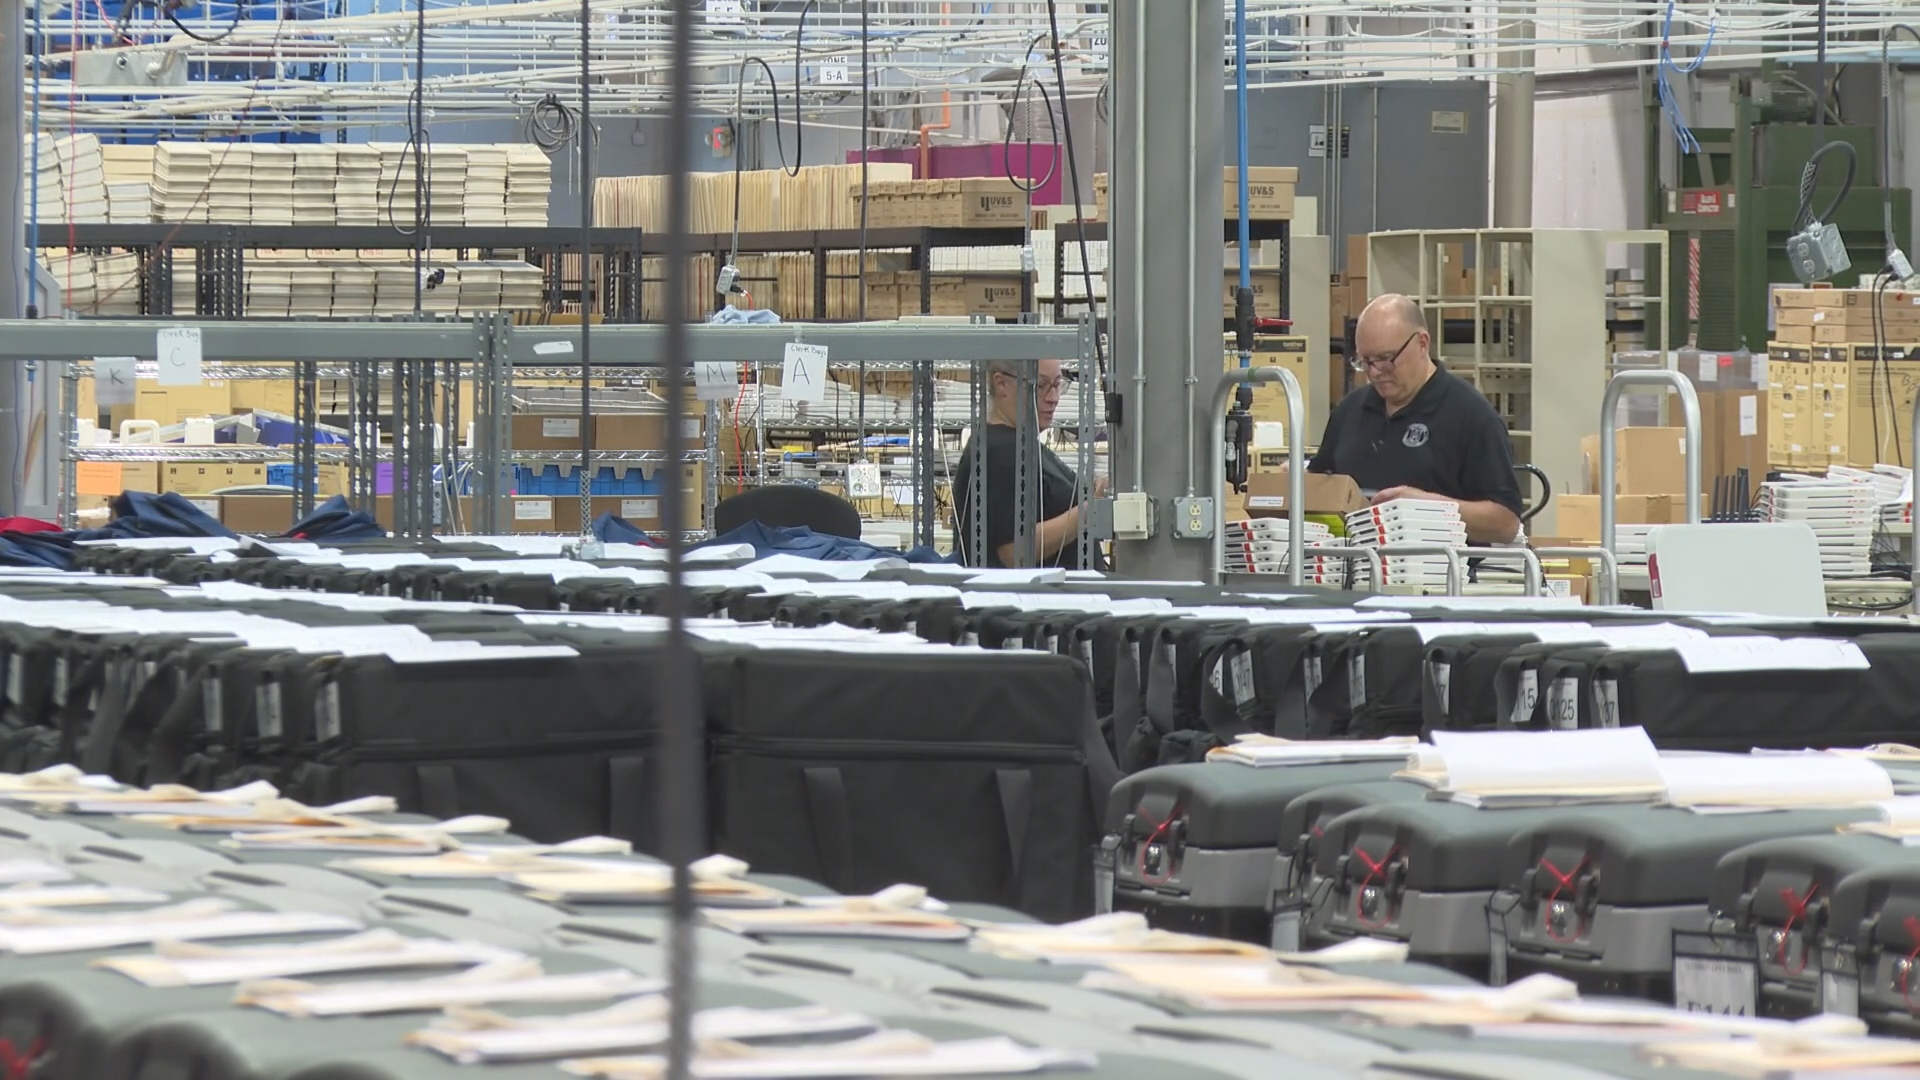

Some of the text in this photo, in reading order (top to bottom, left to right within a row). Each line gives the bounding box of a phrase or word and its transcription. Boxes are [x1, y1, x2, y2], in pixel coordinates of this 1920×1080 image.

[826, 71, 843, 81] 5-A
[1250, 186, 1275, 196] UV&S
[990, 196, 1013, 205] UV&S
[993, 287, 1016, 296] UV&S
[170, 346, 186, 367] C
[109, 367, 124, 385] K
[706, 362, 727, 382] M
[792, 357, 810, 385] A
